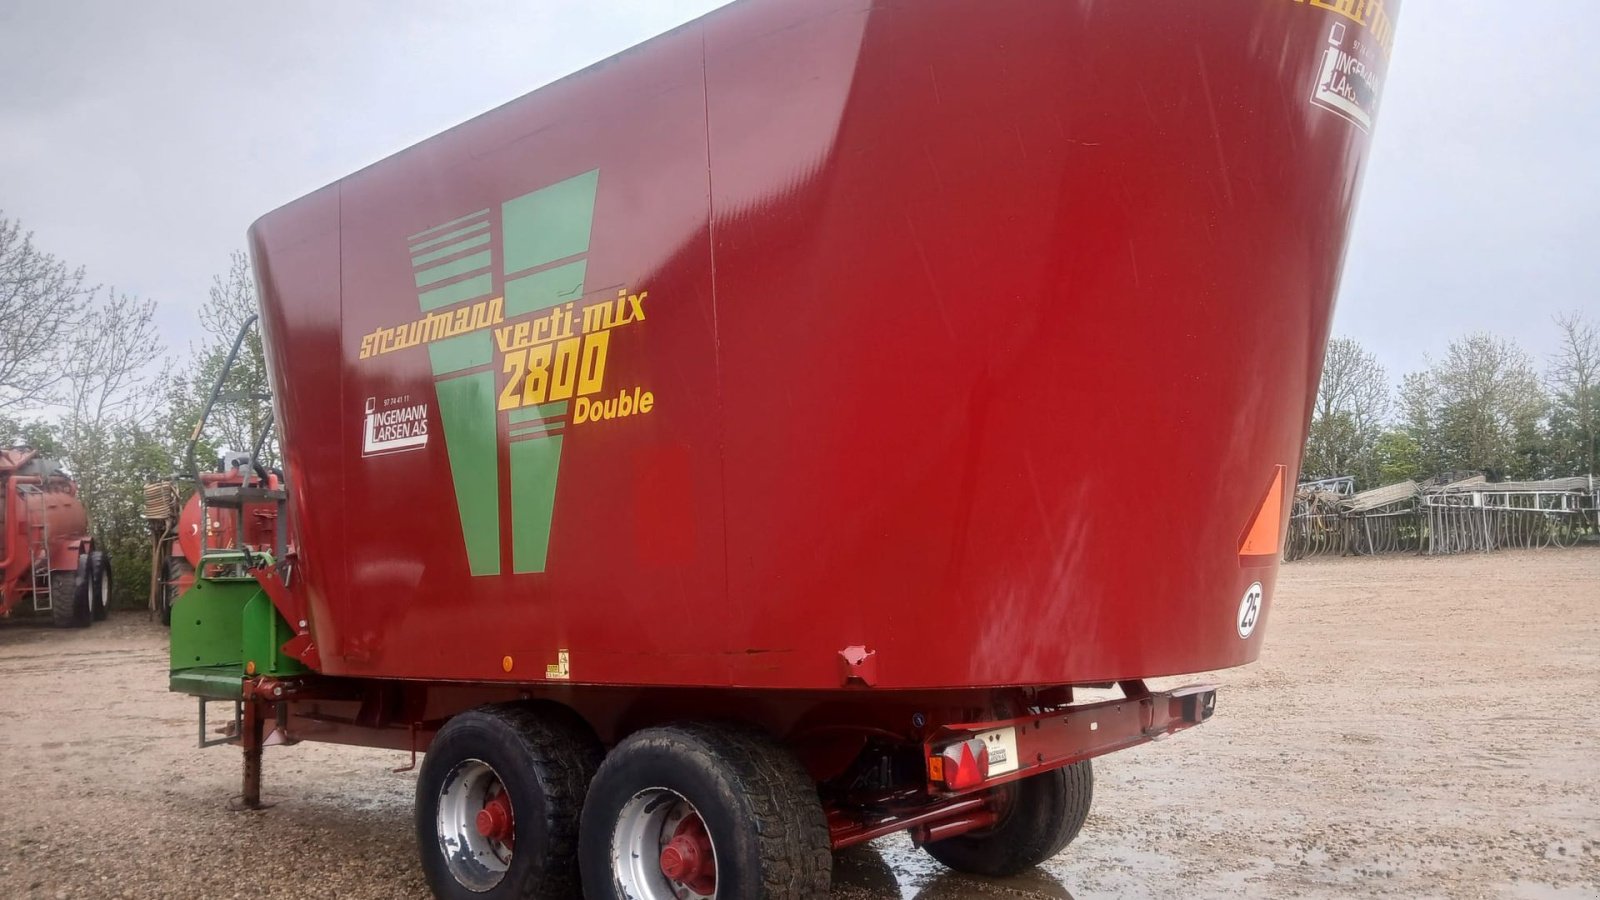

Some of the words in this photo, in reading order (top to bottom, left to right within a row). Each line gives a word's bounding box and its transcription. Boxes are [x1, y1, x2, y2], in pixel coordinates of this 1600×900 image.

[360, 297, 504, 360] strautmann
[494, 288, 648, 352] verti-mix
[498, 330, 610, 411] 2800
[374, 404, 428, 427] INGEMANN
[384, 398, 390, 406] 97
[404, 394, 410, 402] 11
[573, 387, 654, 424] Double
[373, 422, 410, 442] LARSEN
[1241, 592, 1260, 628] 25
